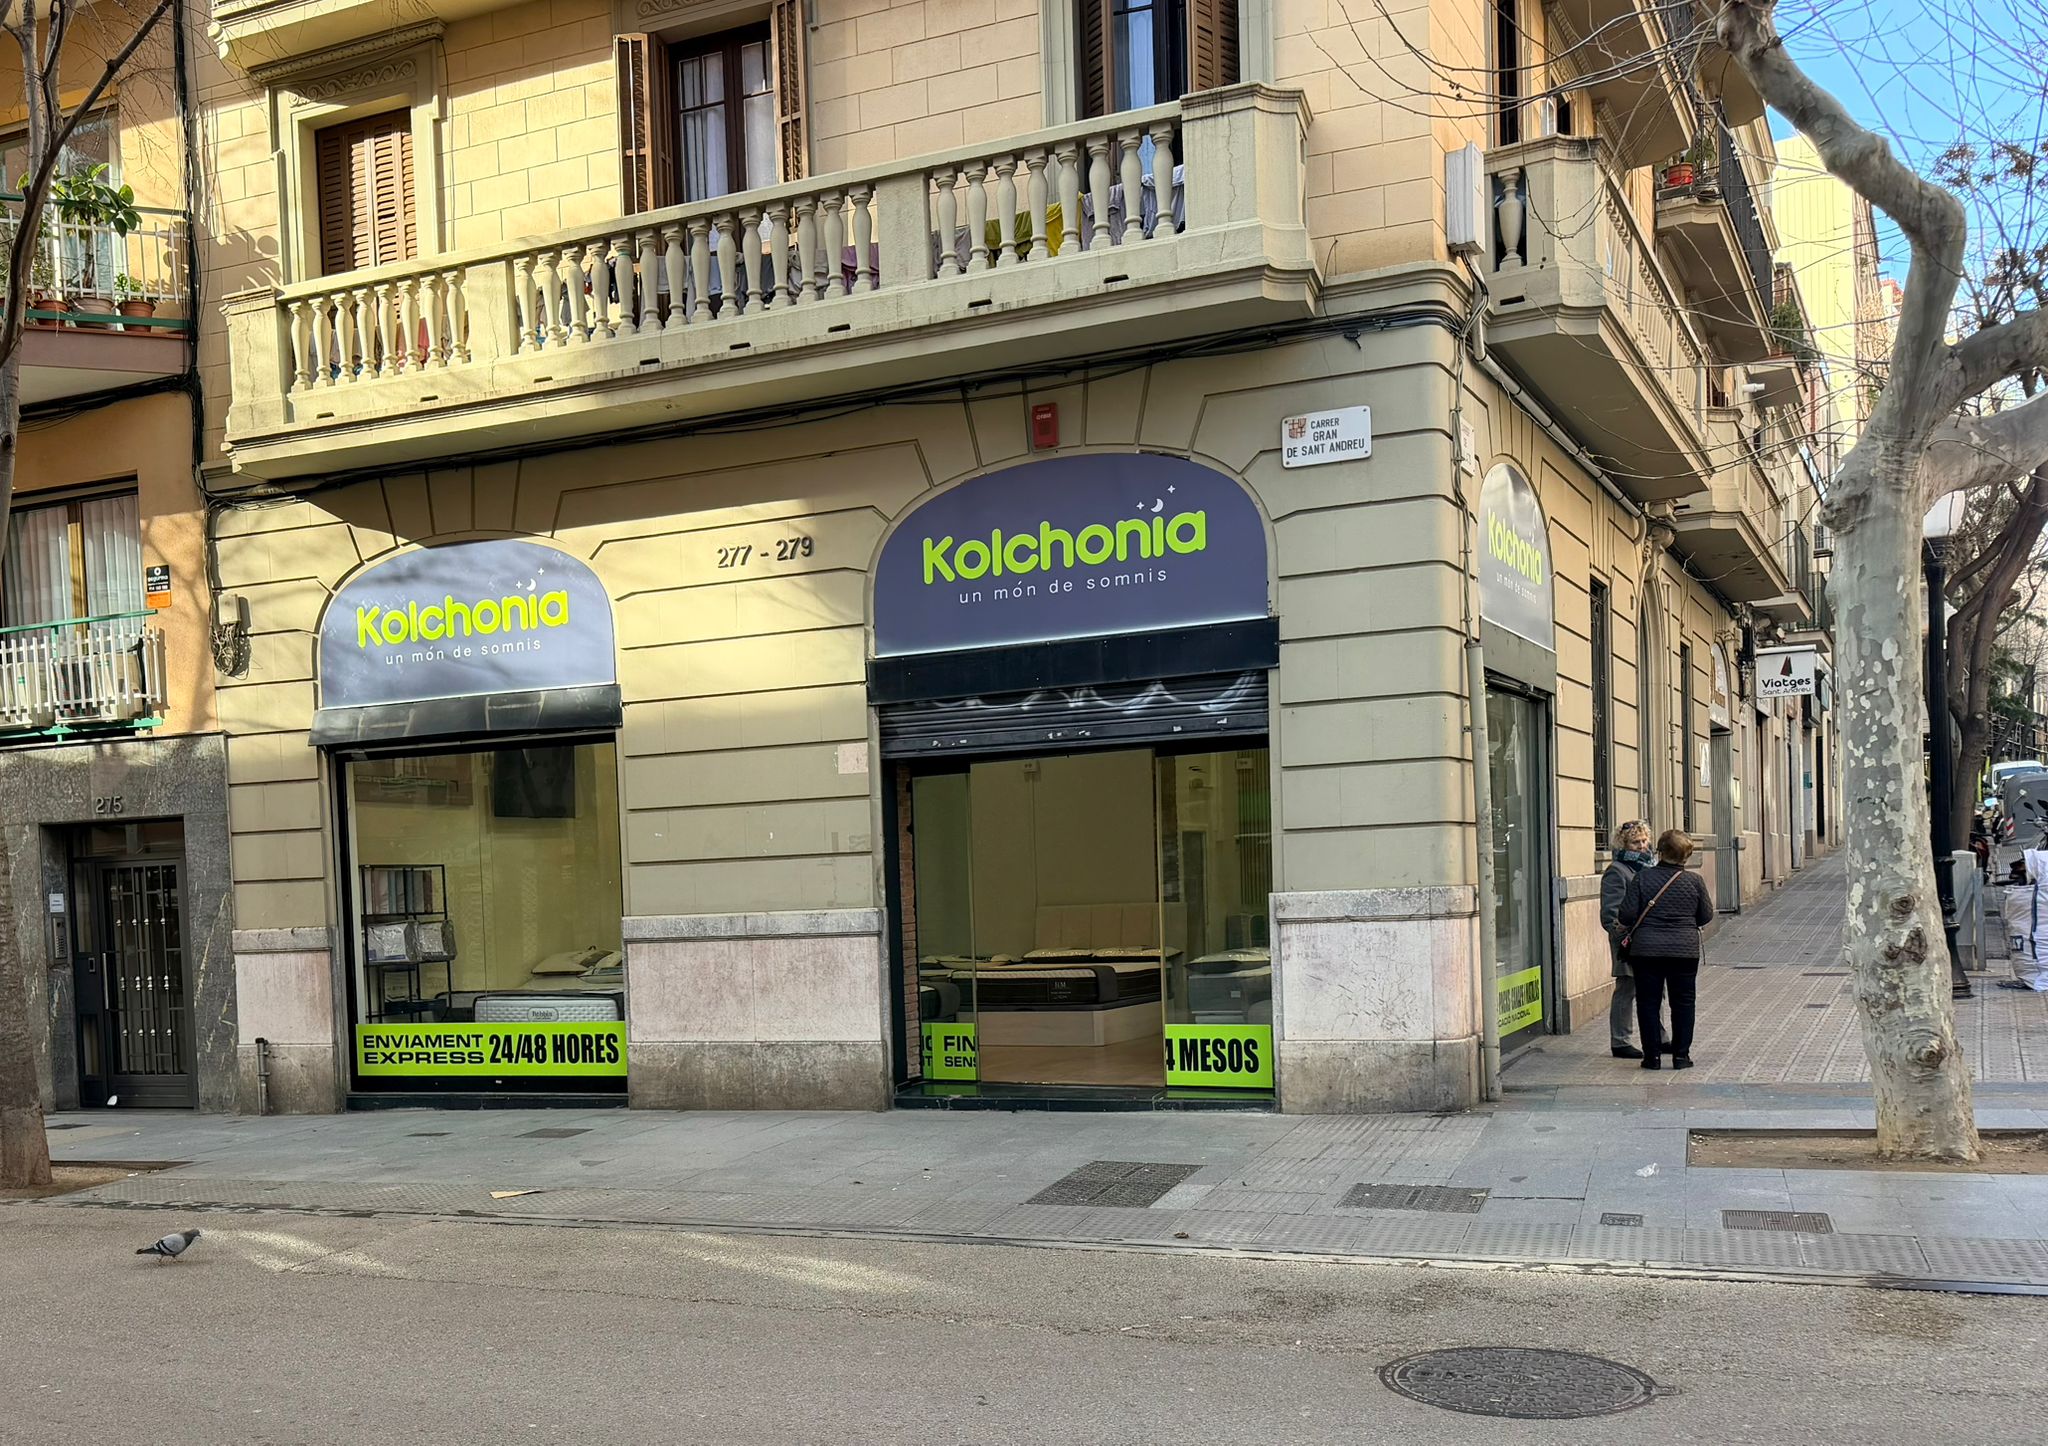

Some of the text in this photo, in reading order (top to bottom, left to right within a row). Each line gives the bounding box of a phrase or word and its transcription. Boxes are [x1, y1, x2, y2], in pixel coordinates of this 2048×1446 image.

[1311, 418, 1340, 429] CARRER
[1313, 429, 1337, 442] GRAN
[1287, 438, 1365, 458] DE SANT ANDREU
[717, 545, 752, 569] 277
[776, 536, 815, 561] 279
[922, 510, 1206, 585] Kolchonia
[1487, 508, 1542, 586] Kolchonia
[959, 567, 1167, 604] un món de somnis
[356, 590, 569, 649] Kolchonia
[386, 638, 542, 665] un món de somnis
[1762, 678, 1811, 688] Viatges
[95, 796, 123, 814] 275
[363, 1034, 483, 1049] ENVIAMENT
[489, 1033, 619, 1064] 24/48 HORES
[943, 1035, 975, 1051] FIN
[364, 1052, 484, 1064] EXPRESS
[1179, 1038, 1259, 1073] MESOS
